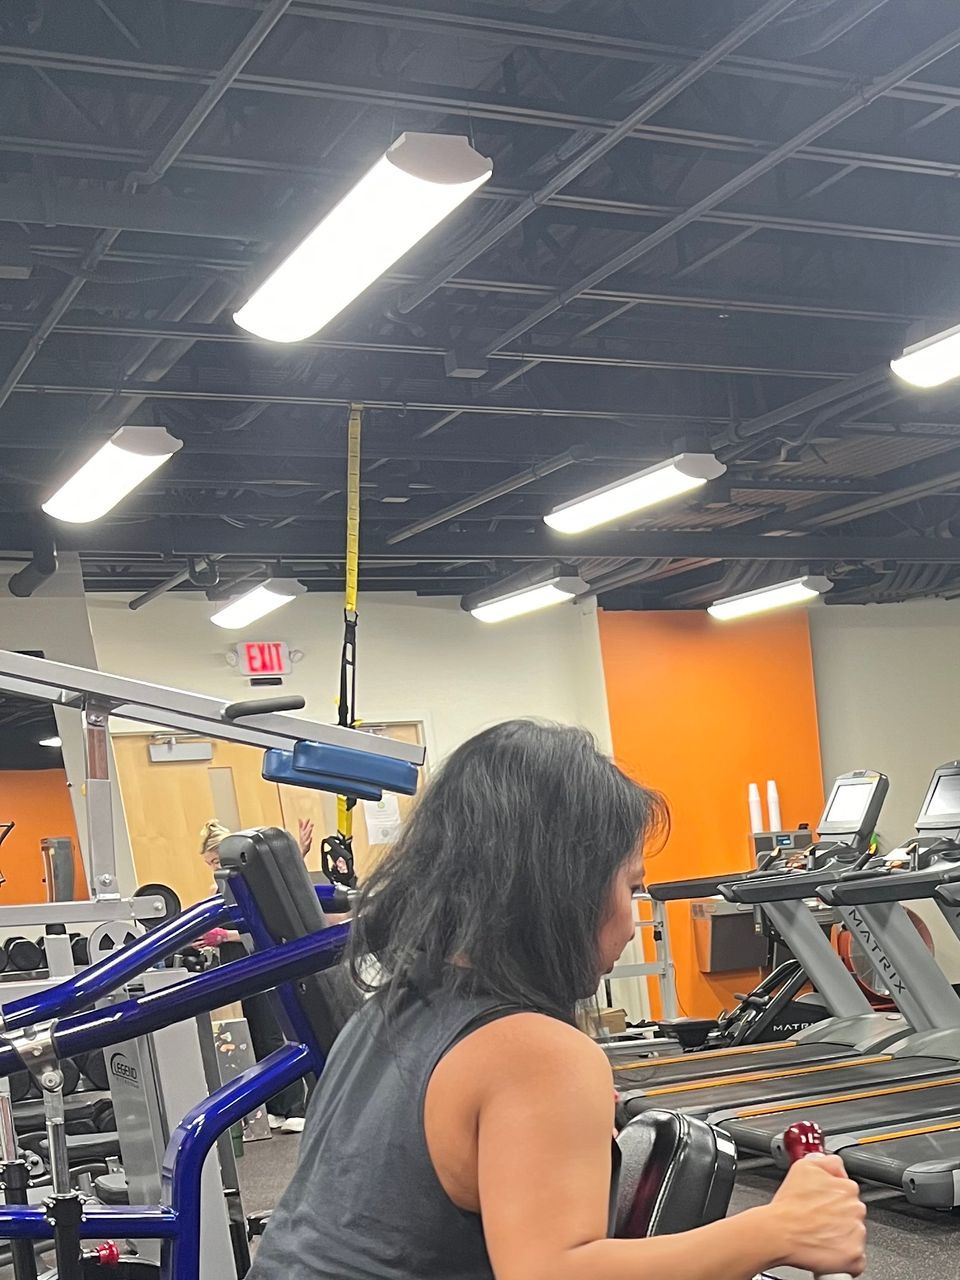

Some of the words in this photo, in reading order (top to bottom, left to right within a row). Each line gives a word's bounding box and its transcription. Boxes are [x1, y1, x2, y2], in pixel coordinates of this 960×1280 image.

[244, 642, 283, 673] EXIT
[849, 908, 907, 995] MATRIX
[773, 1023, 815, 1032] MATR
[113, 1061, 138, 1080] LEGEND
